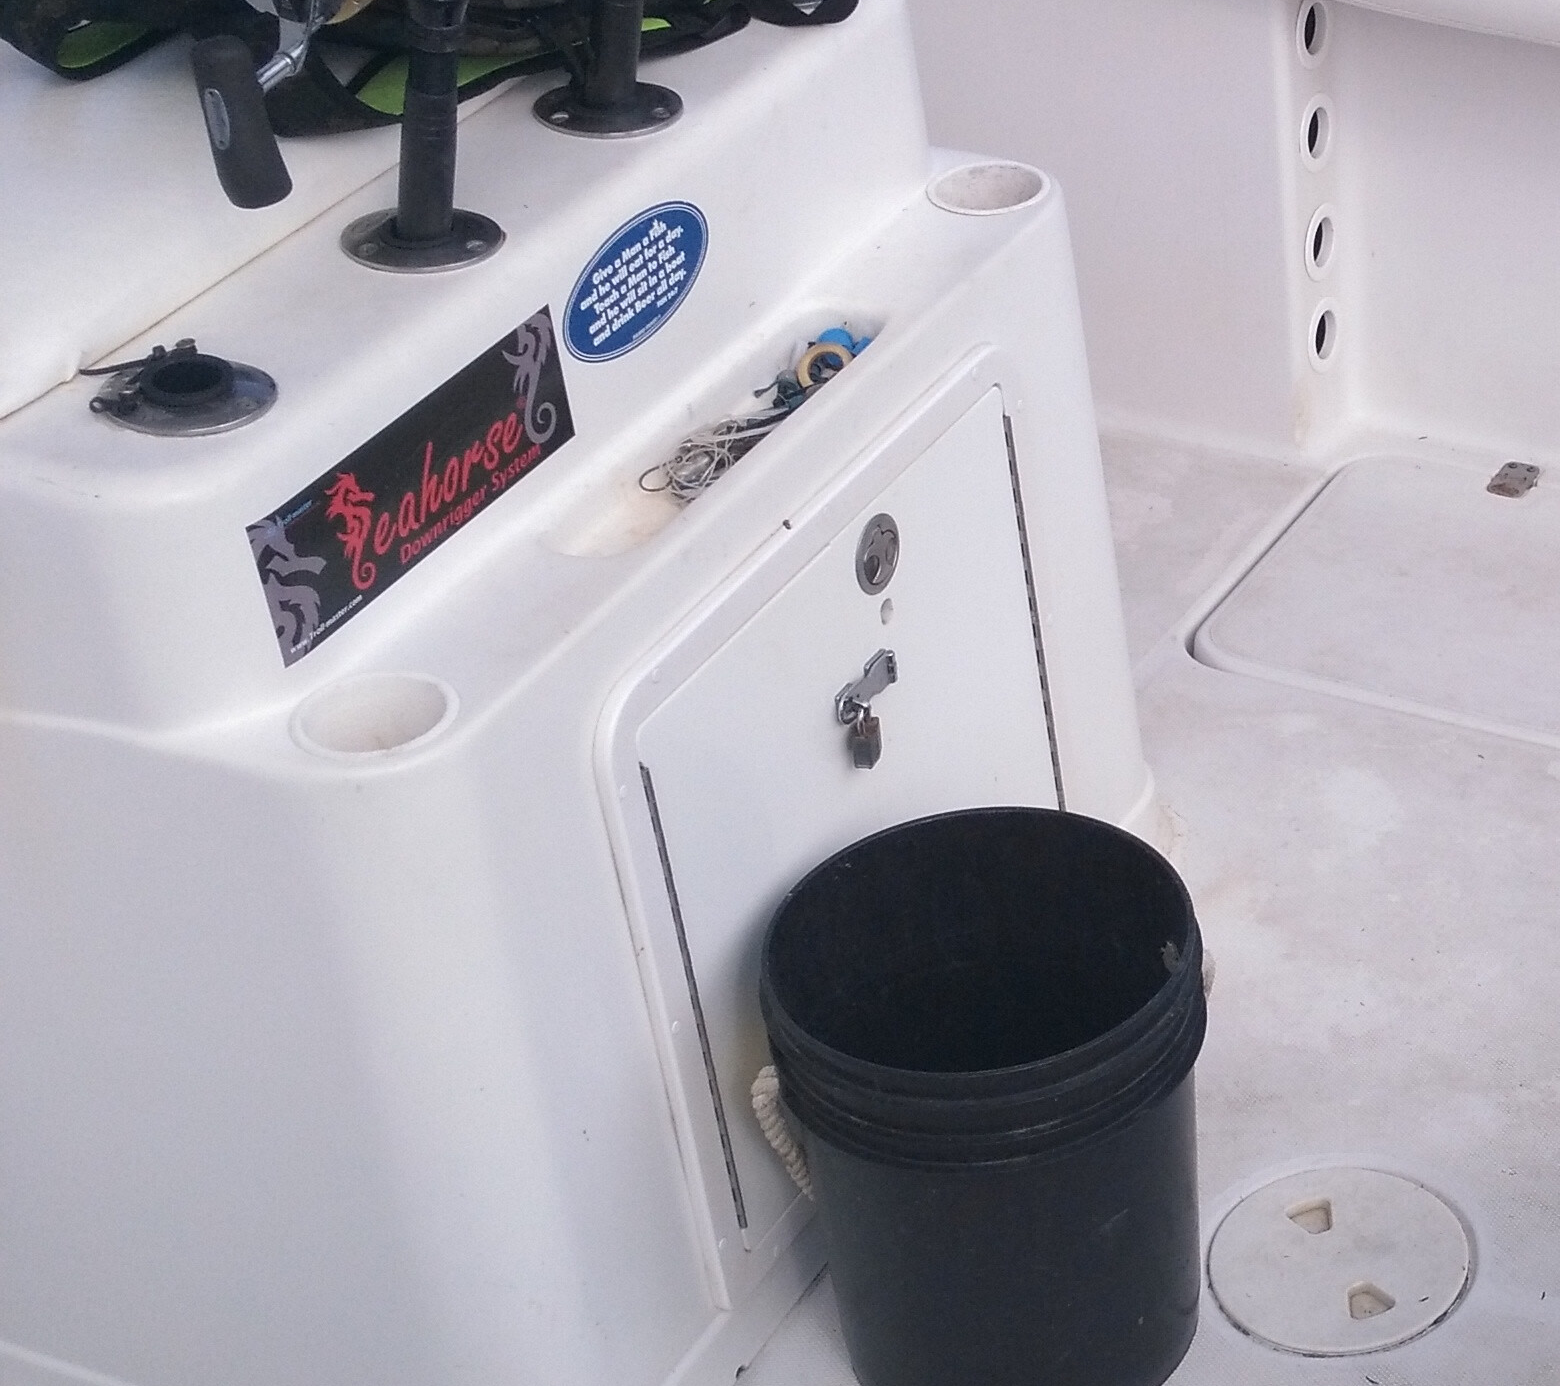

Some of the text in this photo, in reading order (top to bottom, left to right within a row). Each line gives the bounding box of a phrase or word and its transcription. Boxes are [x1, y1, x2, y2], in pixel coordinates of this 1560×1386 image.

[621, 242, 642, 264] Man
[627, 268, 648, 289] Man
[647, 260, 658, 273] to
[580, 289, 598, 311] and
[644, 244, 657, 260] for
[589, 313, 607, 335] and
[648, 275, 658, 288] in
[593, 324, 611, 347] and
[399, 444, 542, 565] Downrigger System
